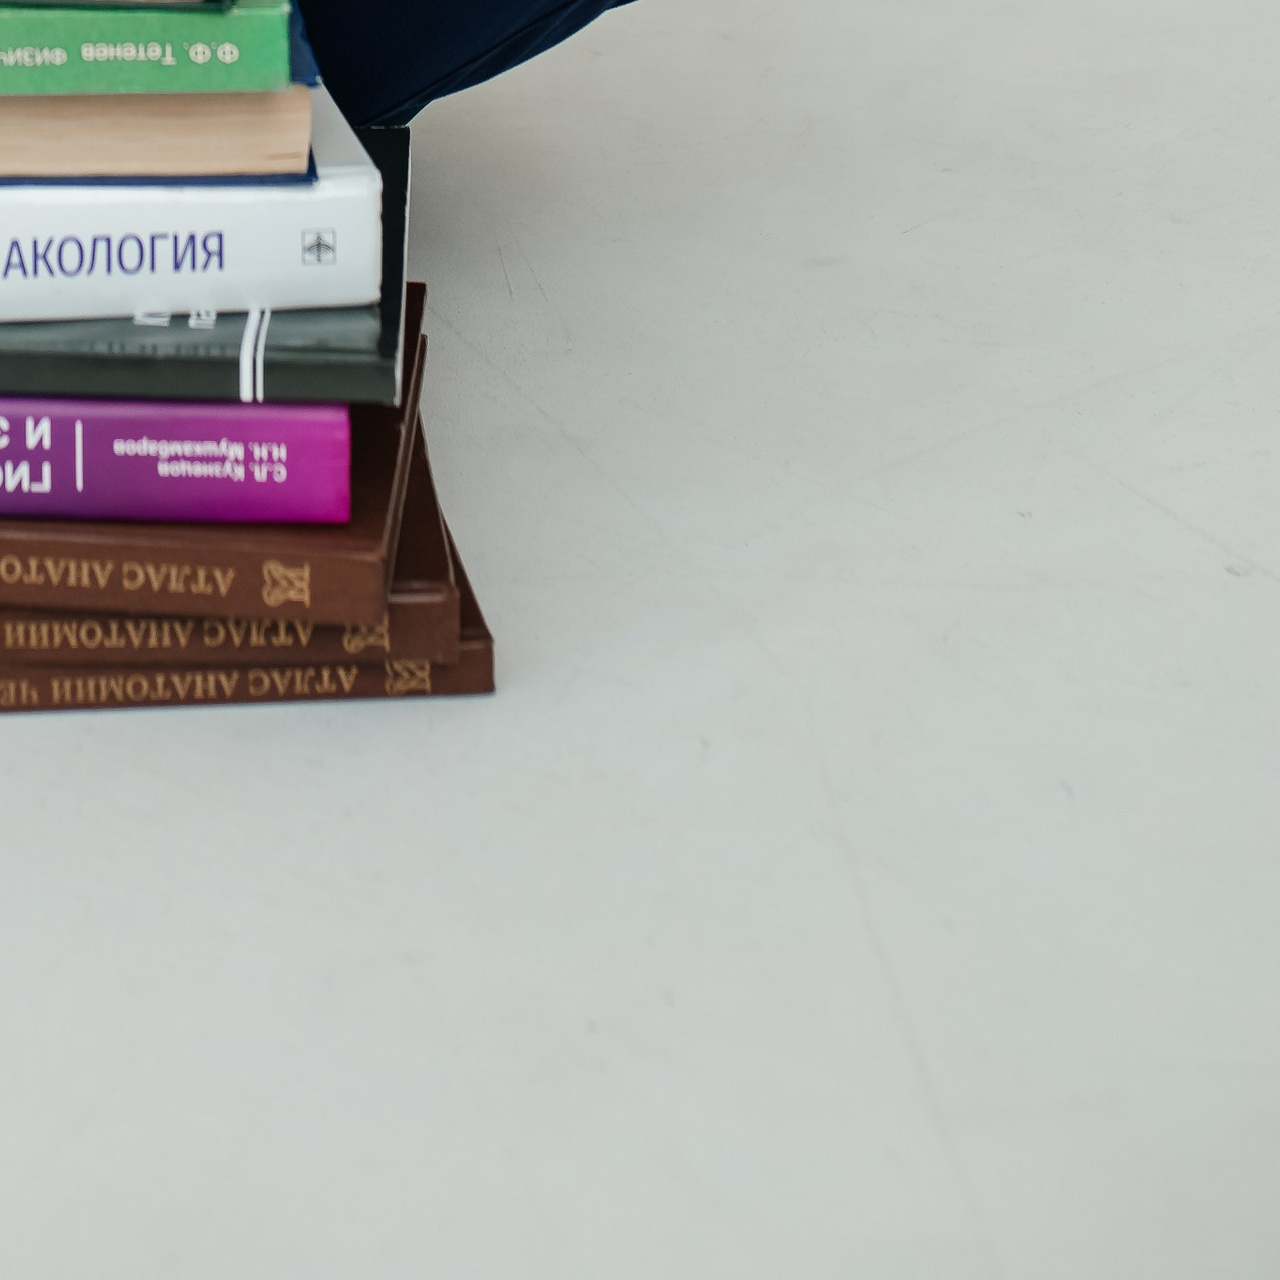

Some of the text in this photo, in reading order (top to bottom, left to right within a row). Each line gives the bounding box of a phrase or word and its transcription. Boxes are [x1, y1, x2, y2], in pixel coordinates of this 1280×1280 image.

[81, 42, 176, 66] Тетенев
[182, 42, 240, 66] Ф.Ф.
[26, 416, 52, 450] И
[157, 463, 247, 483] Кузнецов
[122, 561, 236, 597] АТЛАС
[3, 621, 197, 652] АНАТОМИИ
[203, 618, 313, 650] АТЛАС
[51, 671, 242, 702] АНАТОМИИ
[248, 666, 358, 696] АТЛАС
